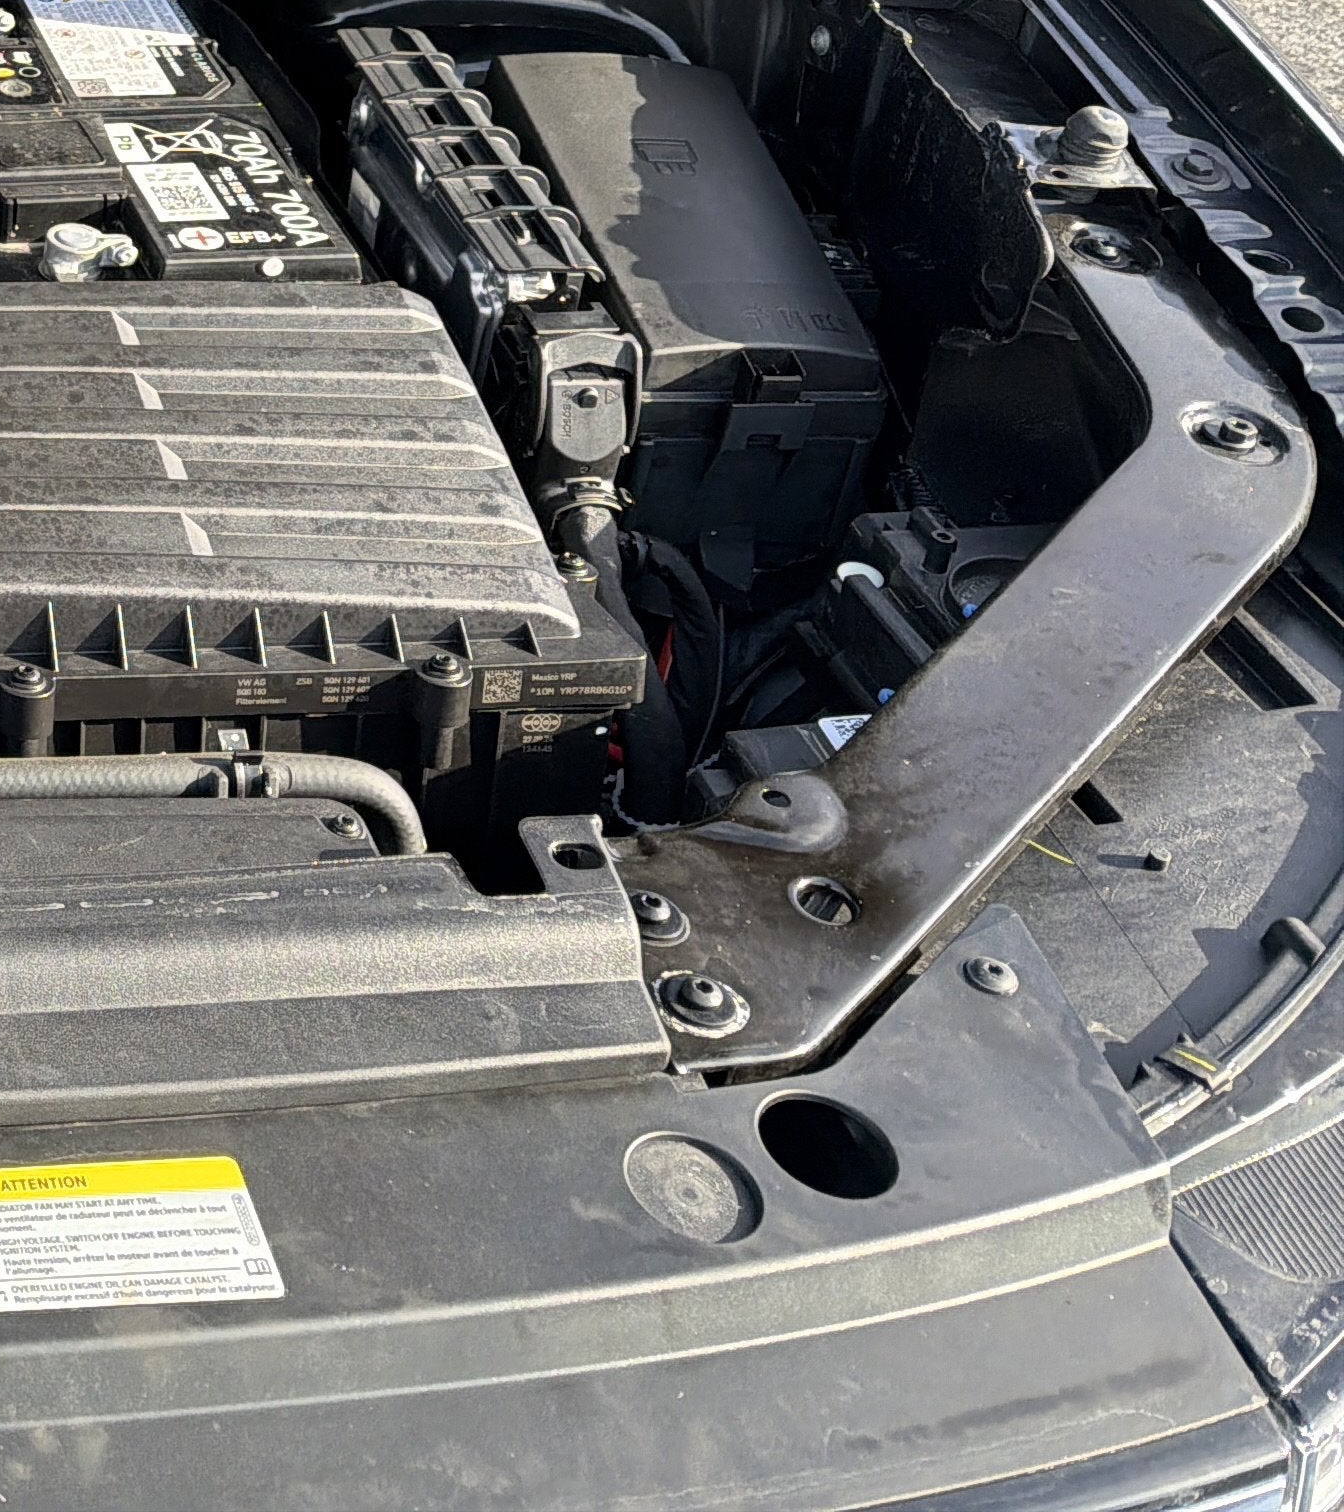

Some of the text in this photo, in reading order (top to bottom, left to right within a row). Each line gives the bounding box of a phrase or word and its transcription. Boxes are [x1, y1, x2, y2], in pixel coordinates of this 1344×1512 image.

[111, 134, 132, 152] Pb
[223, 130, 285, 184] 70Ah
[262, 188, 330, 247] 700A
[224, 229, 286, 245] EFB+
[560, 403, 572, 441] BOSCH
[237, 678, 252, 687] VW
[252, 678, 267, 687] AG
[531, 673, 559, 681] Mexico
[0, 1175, 88, 1193] ATTENTION
[4, 1213, 54, 1223] ventilateur
[55, 1212, 67, 1221] de
[69, 1210, 111, 1220] radiateur
[112, 1209, 135, 1219] peut
[135, 1209, 147, 1217] se
[206, 1204, 227, 1213] tout
[34, 1202, 53, 1211] FAN
[55, 1201, 74, 1210] MAY
[75, 1199, 103, 1209] START
[104, 1198, 115, 1207] AT
[117, 1198, 135, 1206] ANY
[65, 1233, 101, 1243] SWITCH
[103, 1232, 119, 1242] OFF
[122, 1229, 156, 1240] ENGINE
[157, 1228, 193, 1238] BEFORE
[194, 1226, 242, 1237] TOUCHING
[0, 1246, 42, 1256] IGNITION
[3, 1257, 32, 1267] Haute
[106, 1252, 116, 1261] le
[116, 1251, 151, 1261] moteur
[152, 1250, 180, 1259] avant
[180, 1248, 193, 1258] de
[193, 1246, 231, 1257] toucher
[232, 1246, 240, 1255] à
[11, 1281, 68, 1294] OVERFILLED
[69, 1281, 104, 1291] ENGINE
[105, 1280, 121, 1289] OIL
[122, 1279, 142, 1289] CAN
[143, 1276, 182, 1287] DAMAGE
[14, 1292, 73, 1304] Remplissage
[74, 1290, 111, 1301] excessif
[195, 1284, 217, 1296] pour
[218, 1284, 228, 1293] le
